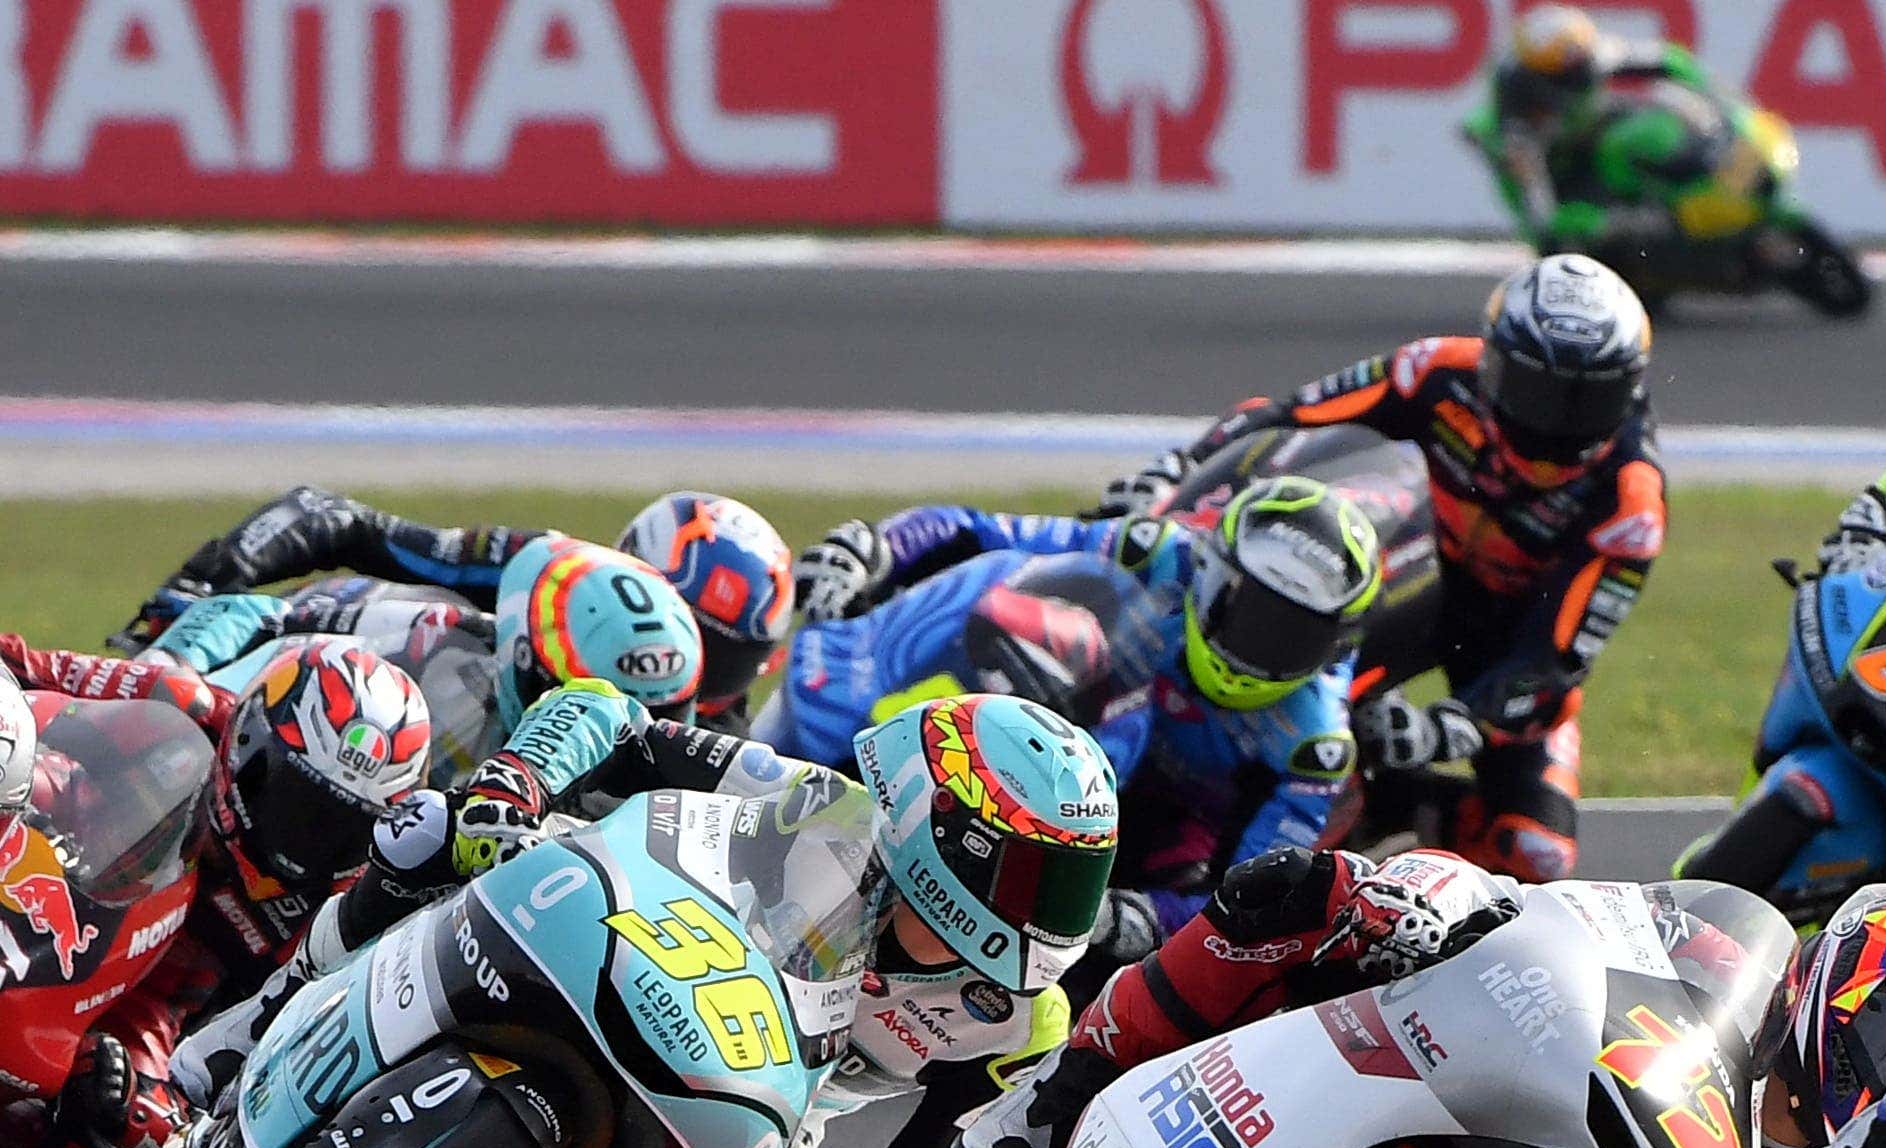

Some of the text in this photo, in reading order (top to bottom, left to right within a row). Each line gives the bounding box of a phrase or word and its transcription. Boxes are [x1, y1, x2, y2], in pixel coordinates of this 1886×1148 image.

[862, 739, 896, 811] SHARK
[1059, 802, 1118, 819] SHARK
[907, 858, 978, 938] LEOPARD
[913, 890, 951, 932] NATURAL
[600, 896, 793, 1072] 36
[633, 970, 708, 1062] LEOPARD
[636, 1003, 677, 1054] NATURAL
[873, 1008, 931, 1061] AYORA
[901, 998, 959, 1048] SHARK
[1401, 1010, 1448, 1068] HRC
[515, 1084, 562, 1142] ANONIMO
[1192, 1035, 1275, 1148] Honda
